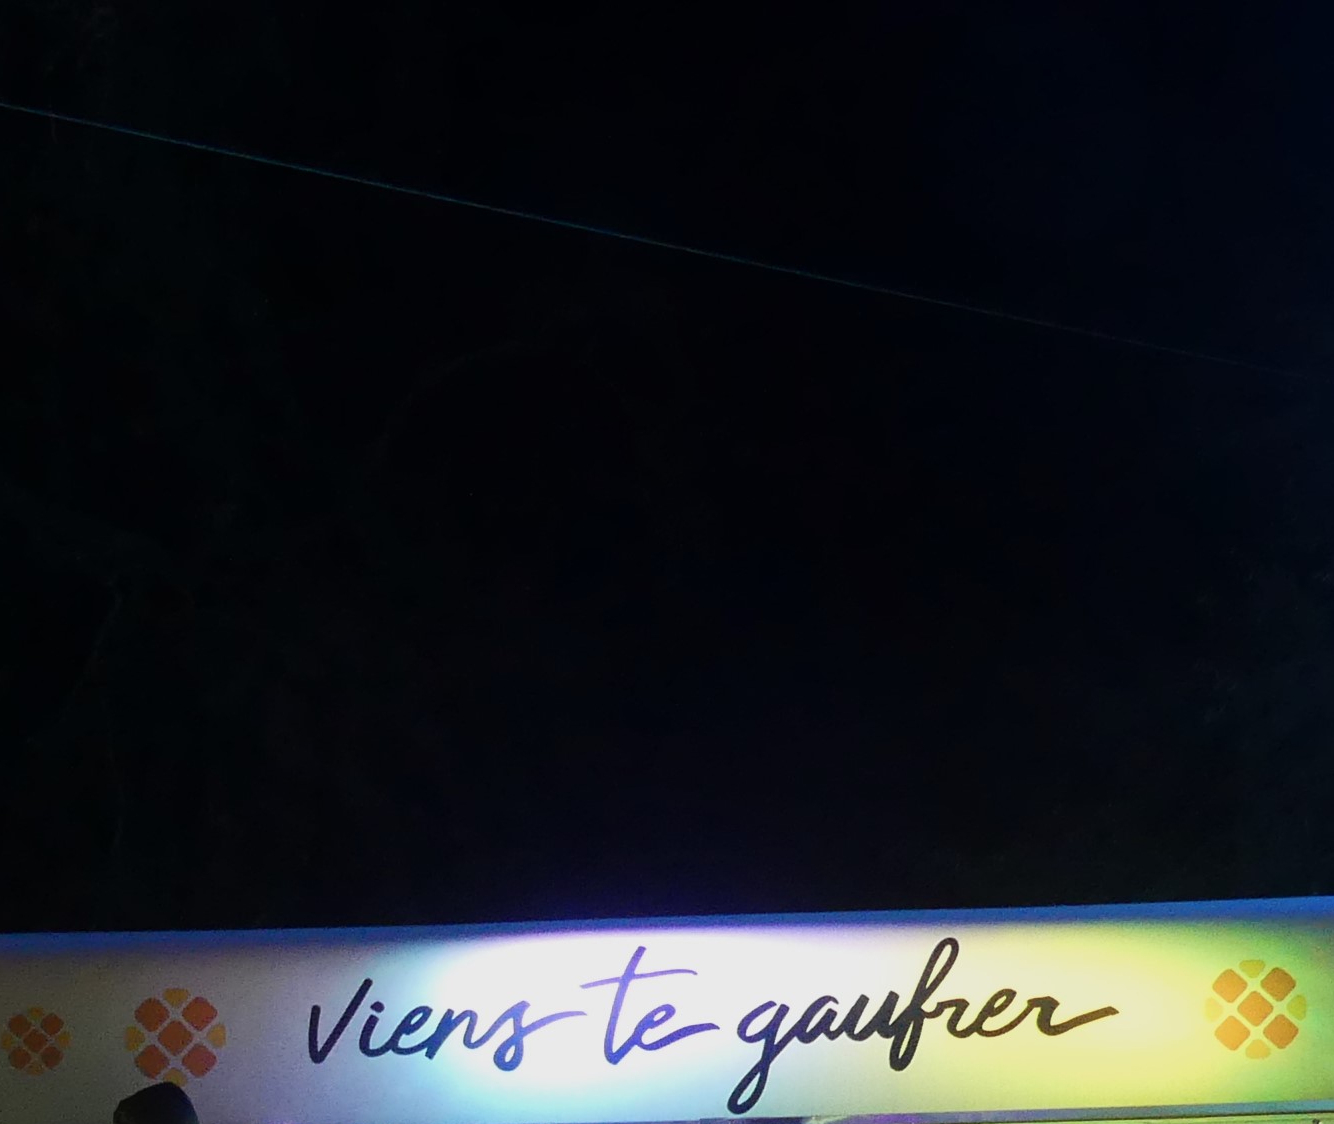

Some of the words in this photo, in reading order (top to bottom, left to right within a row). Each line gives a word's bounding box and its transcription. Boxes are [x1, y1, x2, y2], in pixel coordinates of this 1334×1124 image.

[310, 978, 587, 1072] Viens
[579, 946, 719, 1066] te
[727, 937, 1119, 1115] gaufrer
